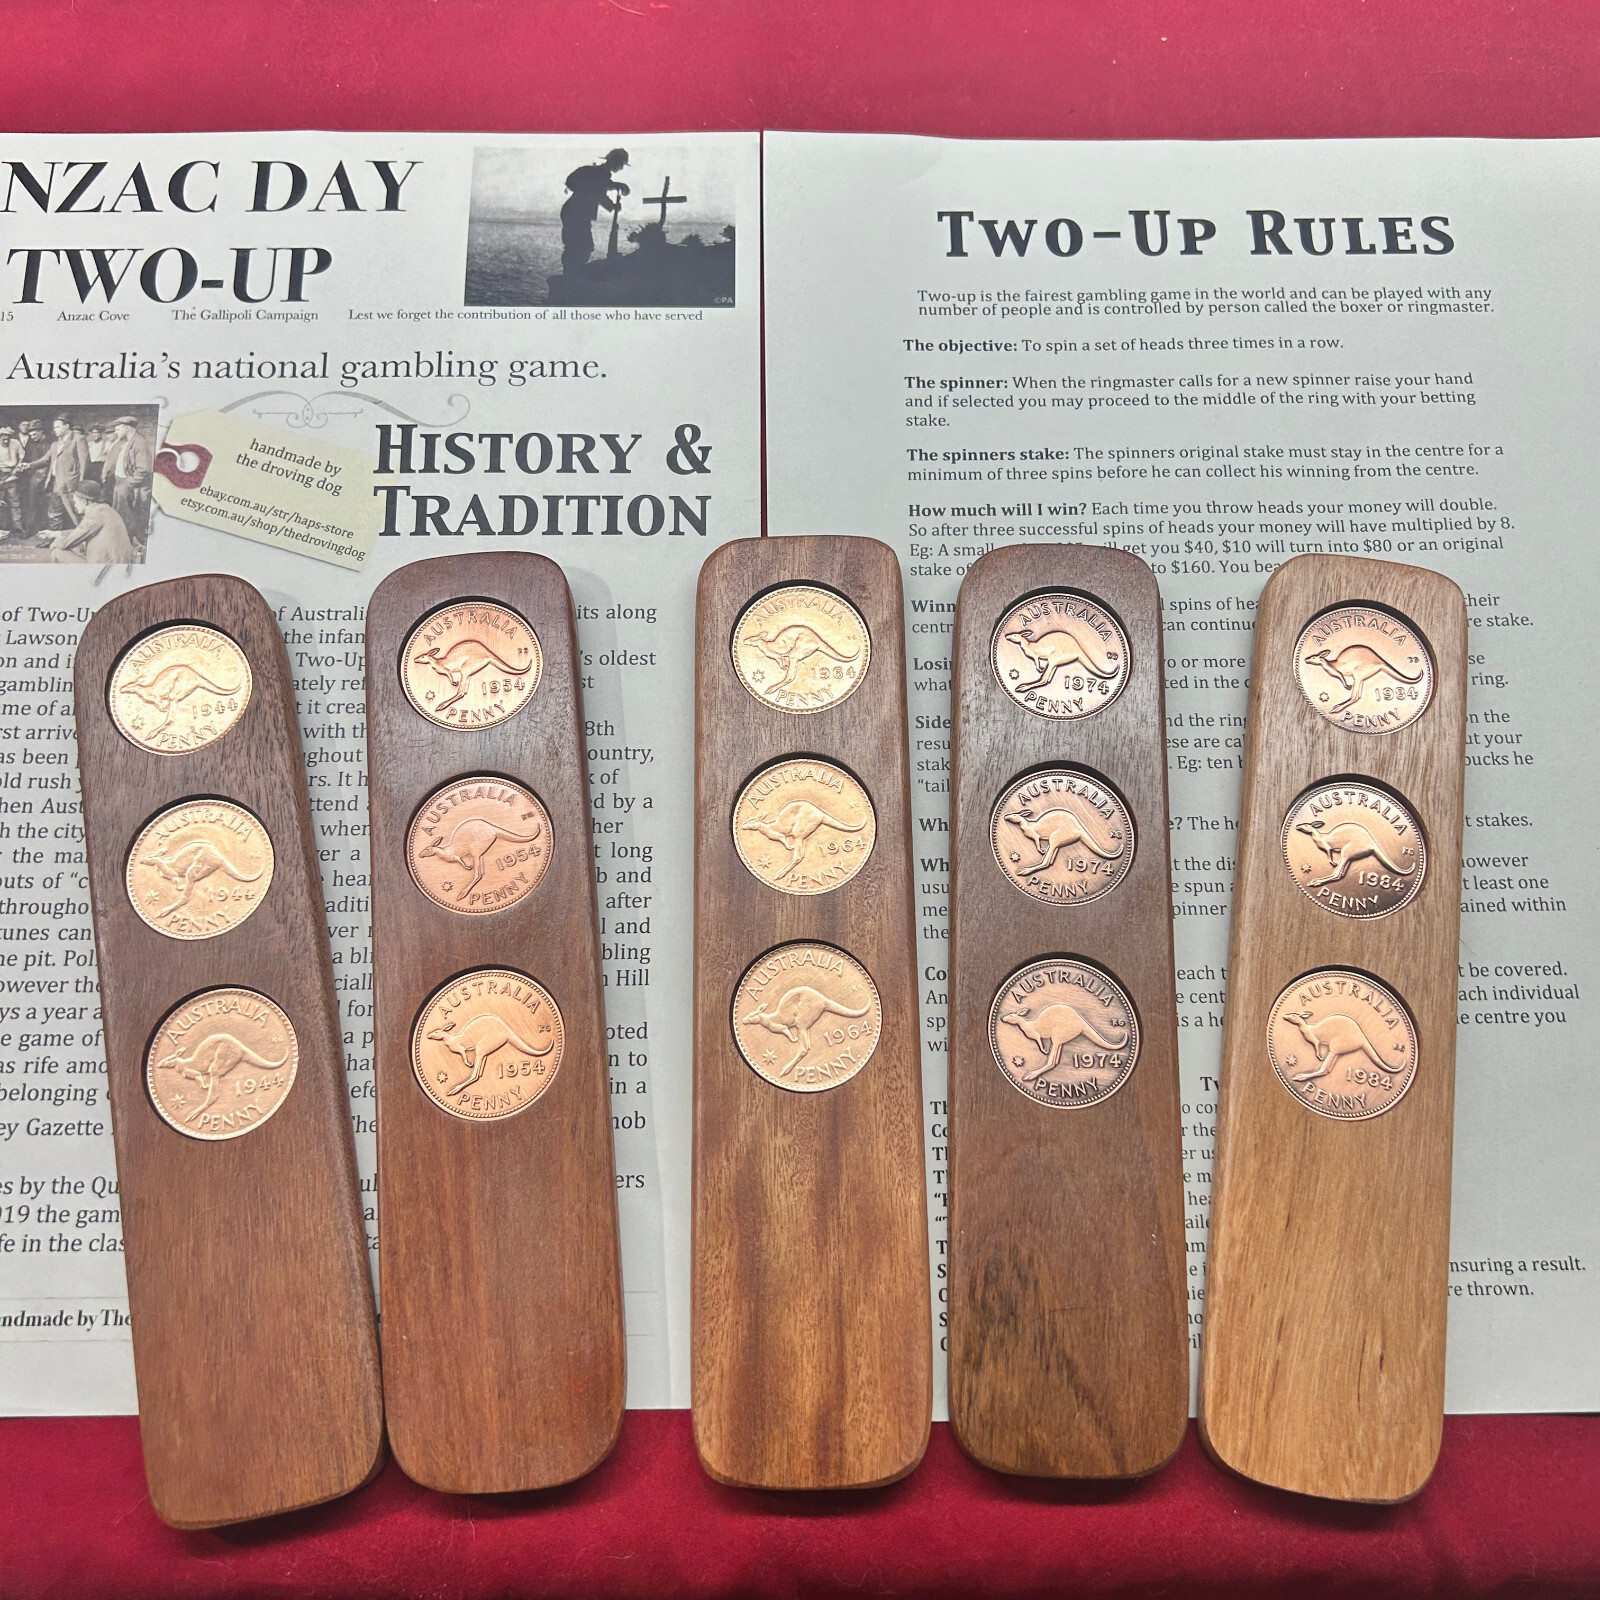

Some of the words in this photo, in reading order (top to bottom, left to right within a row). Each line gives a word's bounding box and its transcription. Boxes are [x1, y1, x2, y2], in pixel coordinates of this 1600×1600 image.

[245, 160, 424, 214] DAY
[1246, 210, 1455, 257] RULES
[7, 247, 333, 305] TWO-UP
[57, 310, 95, 321] Anzac
[99, 310, 130, 322] Cove
[172, 308, 197, 321] The
[200, 308, 252, 324] Gallipoli
[256, 309, 319, 324] Campaign
[348, 309, 374, 320] Lest
[377, 309, 393, 320] we
[396, 309, 431, 323] forget
[434, 309, 454, 320] the
[457, 309, 531, 321] contribution
[535, 309, 549, 320] of
[552, 309, 567, 320] all
[570, 309, 602, 321] those
[605, 309, 631, 321] who
[634, 309, 661, 321] have
[665, 309, 704, 321] served
[903, 339, 934, 351] The
[939, 340, 1018, 354] objective:
[1022, 340, 1041, 351] To
[1046, 339, 1077, 354] spin
[1082, 343, 1090, 351] a
[1095, 340, 1116, 351] set
[1121, 338, 1136, 350] of
[1140, 338, 1184, 350] heads
[1188, 338, 1228, 349] three
[1233, 337, 1274, 349] times
[1279, 337, 1293, 349] in
[1298, 340, 1306, 348] a
[1310, 339, 1344, 348] row.
[6, 351, 181, 380] Australia’s
[192, 351, 329, 379] national
[340, 350, 499, 387] gambling
[508, 358, 608, 387] game.
[249, 438, 322, 470] handmade
[324, 461, 343, 477] by
[373, 424, 642, 475] HISTORY
[666, 423, 713, 475] &
[236, 453, 259, 469] the
[261, 458, 315, 489] droving
[316, 476, 344, 497] dog
[908, 469, 982, 481] minimum
[987, 468, 1003, 480] of
[1007, 467, 1047, 480] three
[1052, 466, 1092, 482] spins
[1097, 466, 1147, 479] before
[1152, 465, 1171, 478] he
[1175, 468, 1201, 478] can
[1206, 464, 1256, 477] collect
[1260, 464, 1282, 477] his
[1287, 465, 1350, 481] winning
[1354, 464, 1391, 477] from
[1396, 464, 1421, 476] the
[1426, 465, 1478, 476] centre.
[199, 485, 354, 539] ebay.com.au/str/haps-store
[373, 486, 712, 537] TRADITION
[180, 495, 366, 562] etsy.com.au/shop/thedrovingdog
[2, 607, 23, 622] of
[606, 604, 657, 624] along
[753, 595, 846, 628] AUSTRALIA
[1486, 613, 1534, 628] stake.
[424, 611, 518, 646] AUSTRALIA
[1019, 602, 1113, 642] AUSTRALIA
[1312, 614, 1408, 647] AUSTRALIA
[6, 630, 78, 646] Lawson
[131, 633, 226, 675] AUSTRALIA
[599, 649, 656, 667] oldest
[1182, 658, 1198, 670] or
[1203, 658, 1246, 670] more
[810, 666, 857, 681] 1964
[1471, 672, 1509, 688] ring.
[482, 677, 525, 695] 1954
[1064, 675, 1110, 695] 1974
[1375, 686, 1419, 702] 1984
[193, 698, 238, 718] 1944
[446, 700, 506, 723] PENNY
[1024, 691, 1084, 714] PENNY
[1341, 707, 1401, 728] PENNY
[1484, 710, 1510, 724] the
[303, 722, 346, 739] with
[1484, 732, 1523, 747] your
[22, 749, 68, 765] been
[1513, 751, 1534, 765] he
[28, 773, 72, 790] rush
[748, 767, 845, 810] AUSTRALIA
[613, 795, 635, 812] by
[642, 798, 654, 810] a
[1019, 778, 1115, 820] AUSTRALIA
[421, 786, 516, 837] AUSTRALIA
[1309, 791, 1409, 836] AUSTRALIA
[1476, 812, 1533, 828] stakes.
[155, 808, 253, 845] AUSTRALIA
[496, 844, 542, 871] 1954
[611, 842, 653, 861] long
[819, 837, 866, 858] 1964
[1066, 857, 1115, 876] 1974
[469, 872, 529, 906] PENNY
[1027, 875, 1088, 898] PENNY
[1358, 871, 1405, 892] 1984
[1473, 875, 1514, 891] least
[1518, 877, 1549, 890] one
[605, 893, 652, 909] after
[1316, 886, 1379, 911] PENNY
[1512, 897, 1567, 913] within
[58, 927, 91, 942] can
[614, 918, 651, 934] and
[24, 952, 56, 971] pit.
[1469, 962, 1490, 978] be
[1494, 960, 1568, 978] covered.
[616, 969, 650, 987] Hill
[745, 950, 845, 1002] AUSTRALIA
[1011, 970, 1115, 1008] AUSTRALIA
[1492, 983, 1580, 1001] individual
[439, 980, 541, 1020] AUSTRALIA
[1298, 980, 1399, 1030] AUSTRALIA
[41, 1006, 89, 1024] year
[166, 999, 270, 1045] AUSTRALIA
[1475, 1009, 1530, 1025] centre
[1534, 1011, 1567, 1027] you
[18, 1031, 75, 1051] game
[81, 1029, 106, 1048] of
[823, 1021, 873, 1047] 1964
[23, 1056, 59, 1076] rife
[499, 1059, 546, 1079] 1954
[1072, 1053, 1123, 1068] 1974
[236, 1073, 284, 1096] 1944
[1034, 1076, 1100, 1098] PENNY
[1346, 1067, 1393, 1091] 1984
[457, 1085, 522, 1111] PENNY
[1302, 1082, 1367, 1110] PENNY
[198, 1097, 263, 1131] PENNY
[26, 1117, 105, 1137] Gazette
[1518, 1260, 1528, 1272] a
[1532, 1256, 1586, 1273] result.
[1467, 1281, 1535, 1297] thrown.
